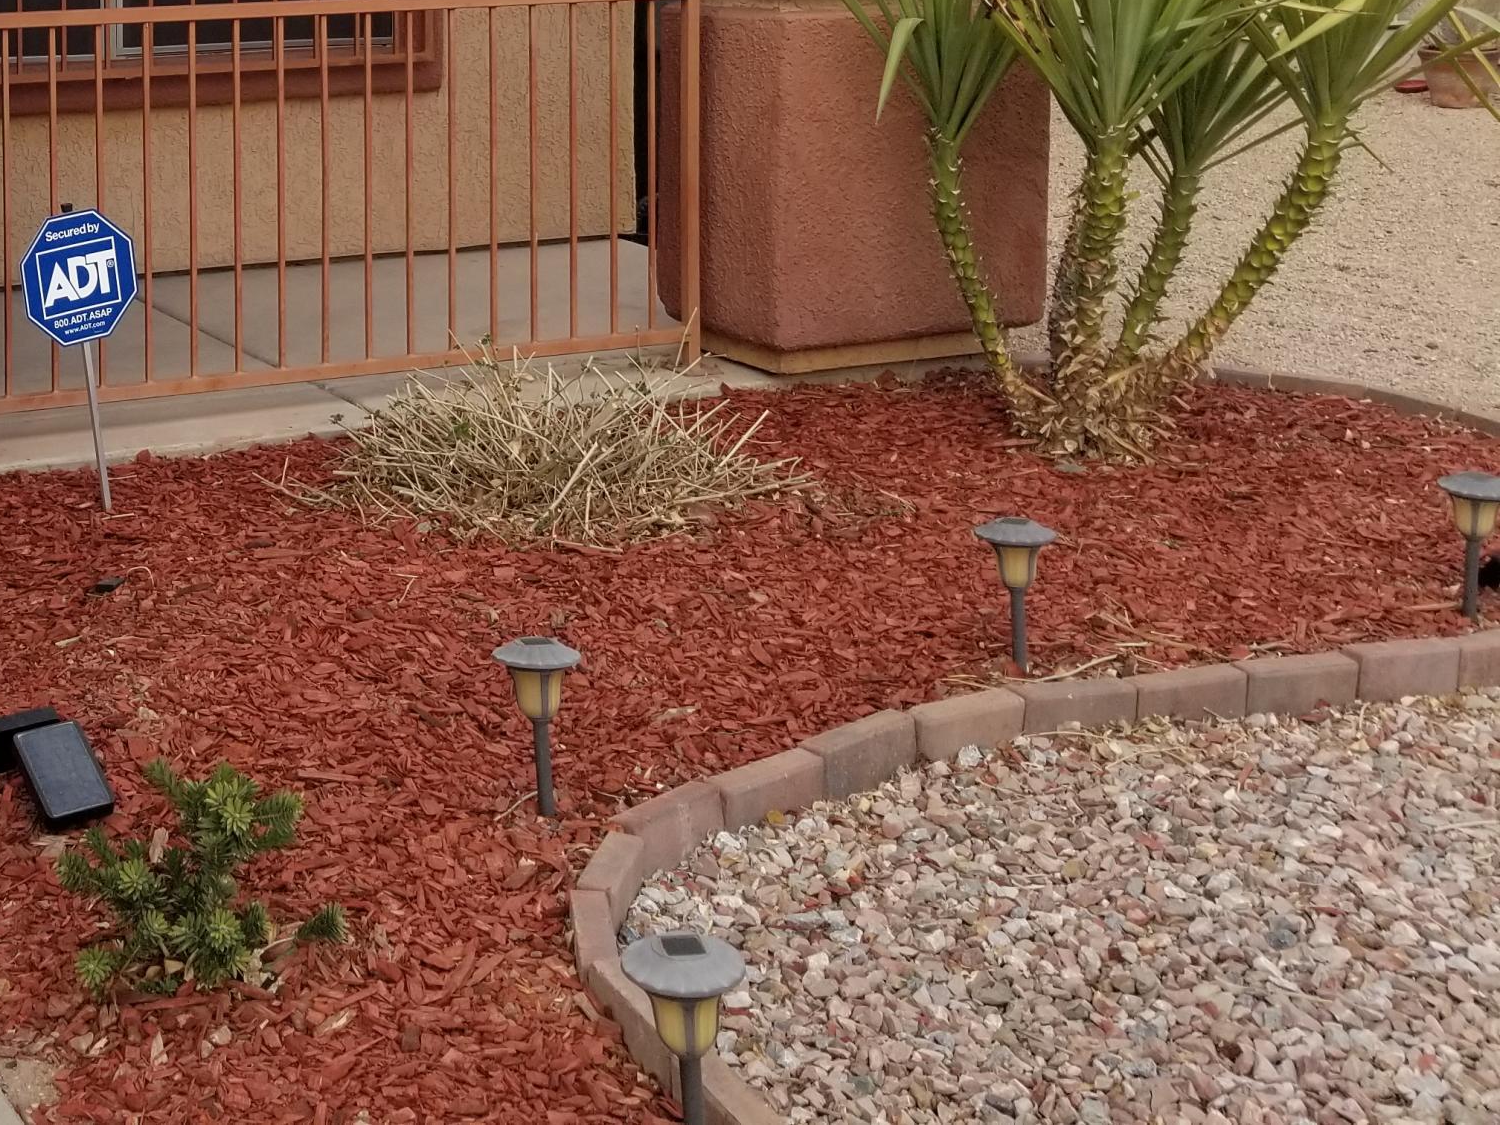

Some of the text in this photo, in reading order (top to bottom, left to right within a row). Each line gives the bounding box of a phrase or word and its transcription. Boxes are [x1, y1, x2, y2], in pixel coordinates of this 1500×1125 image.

[45, 222, 100, 242] Secured by
[44, 248, 116, 308] ADT
[64, 321, 106, 335] www.ADT.com
